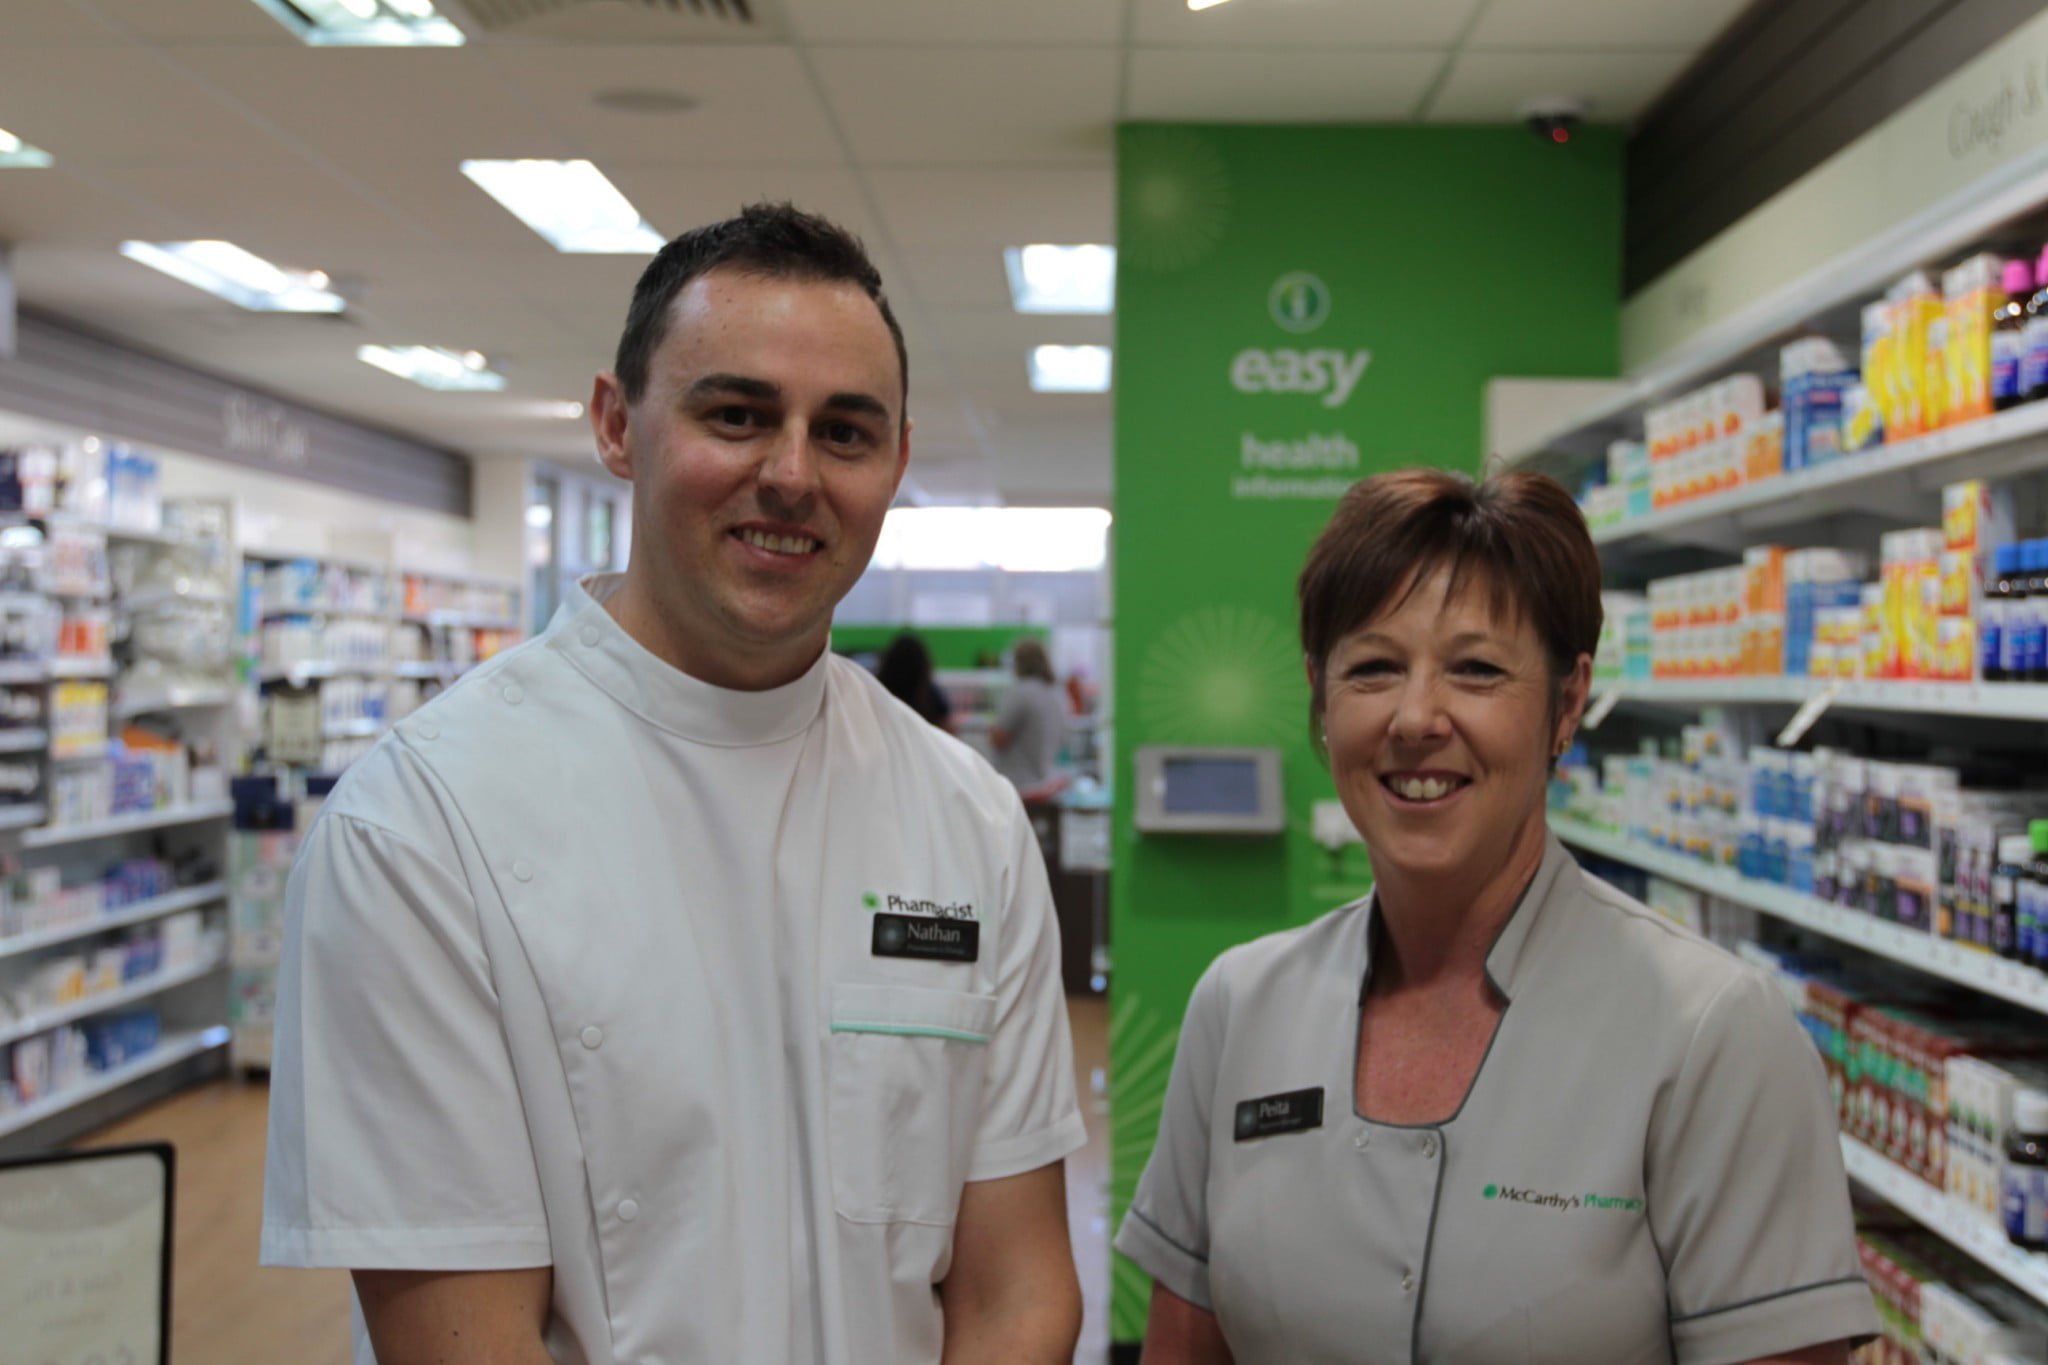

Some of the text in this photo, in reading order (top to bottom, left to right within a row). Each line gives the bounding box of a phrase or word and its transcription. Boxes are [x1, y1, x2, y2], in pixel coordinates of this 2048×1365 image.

[1231, 347, 1371, 407] easy
[1241, 431, 1360, 469] health
[1231, 475, 1356, 498] informatio
[887, 894, 974, 920] Pharmacist
[907, 922, 961, 943] Nathan
[1499, 1186, 1580, 1212] McCarthy's
